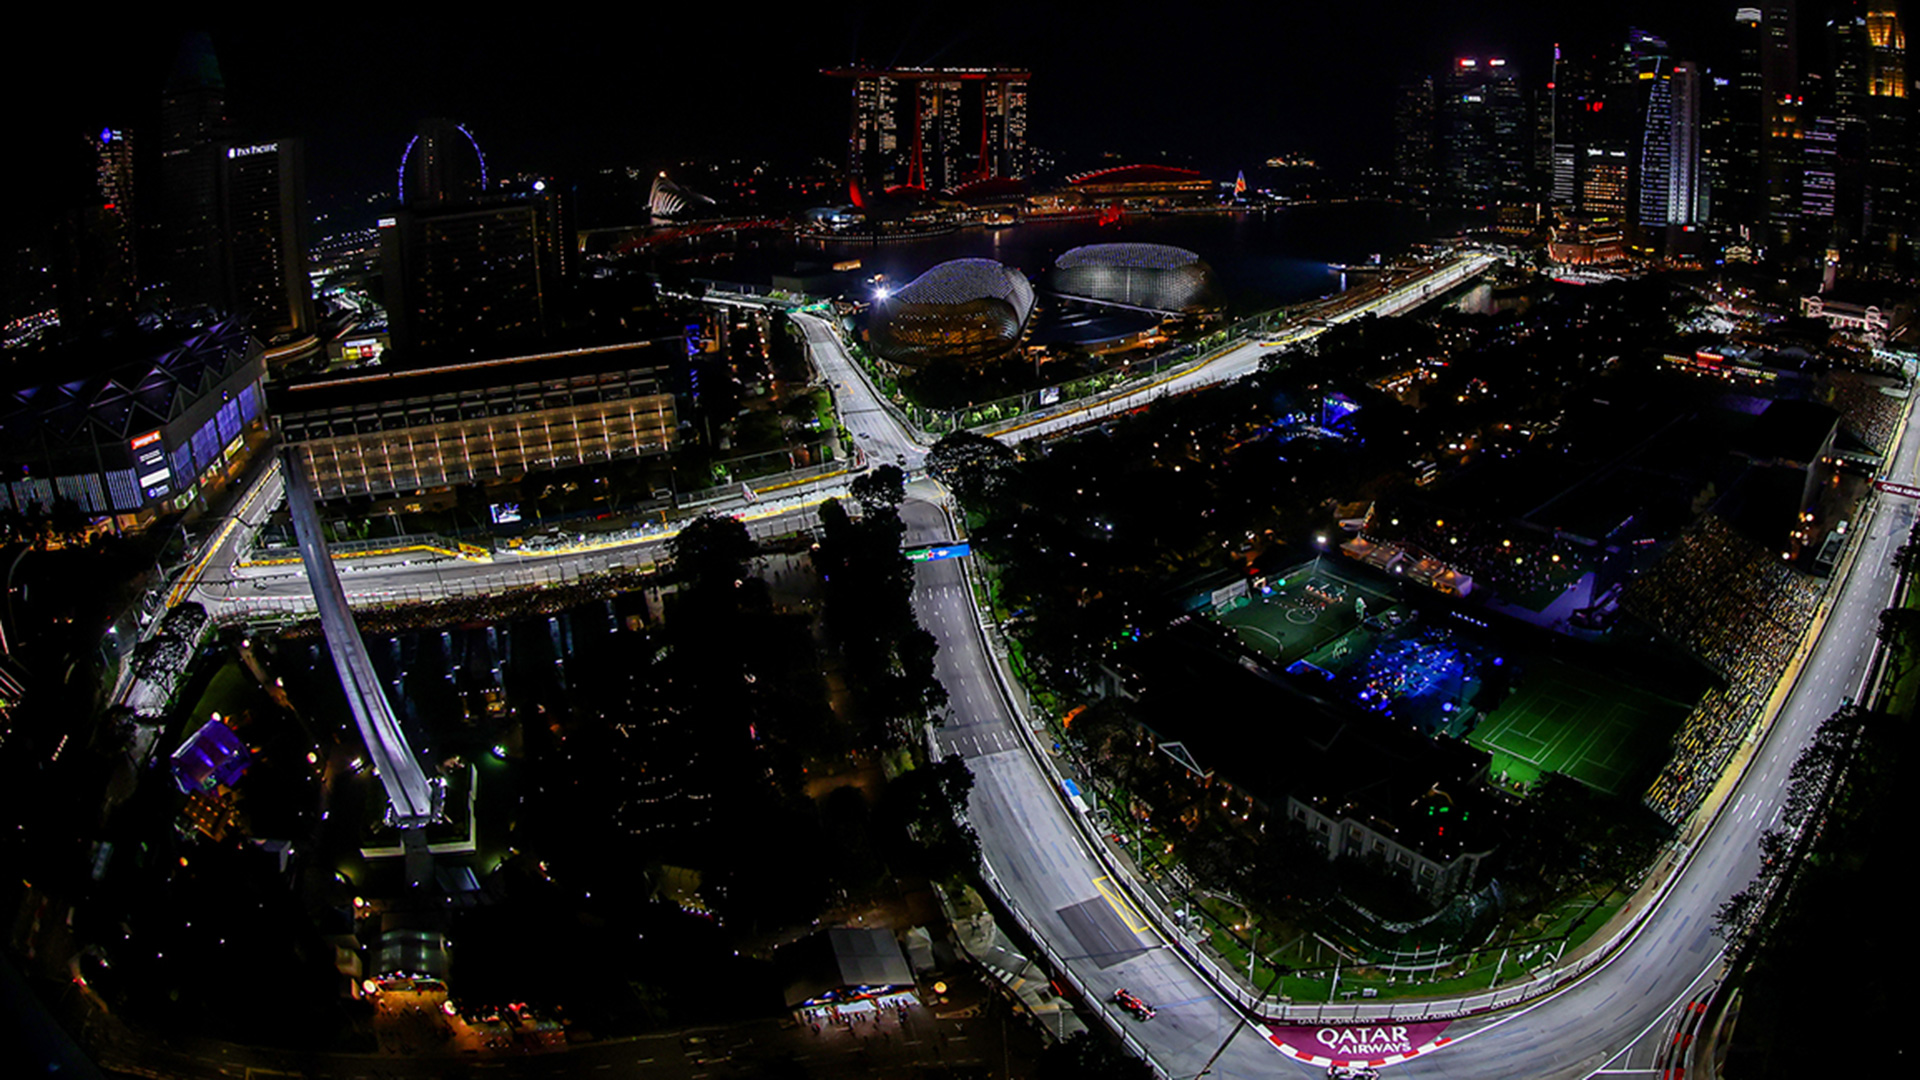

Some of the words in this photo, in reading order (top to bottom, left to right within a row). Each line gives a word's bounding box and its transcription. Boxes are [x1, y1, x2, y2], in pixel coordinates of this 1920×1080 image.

[1334, 1017, 1376, 1025] AIRWAYS
[1396, 1014, 1429, 1023] QATAR
[1430, 1009, 1472, 1020] AIRWAYS
[1316, 1026, 1409, 1049] QATAR
[1338, 1042, 1411, 1055] AIRWAYS
